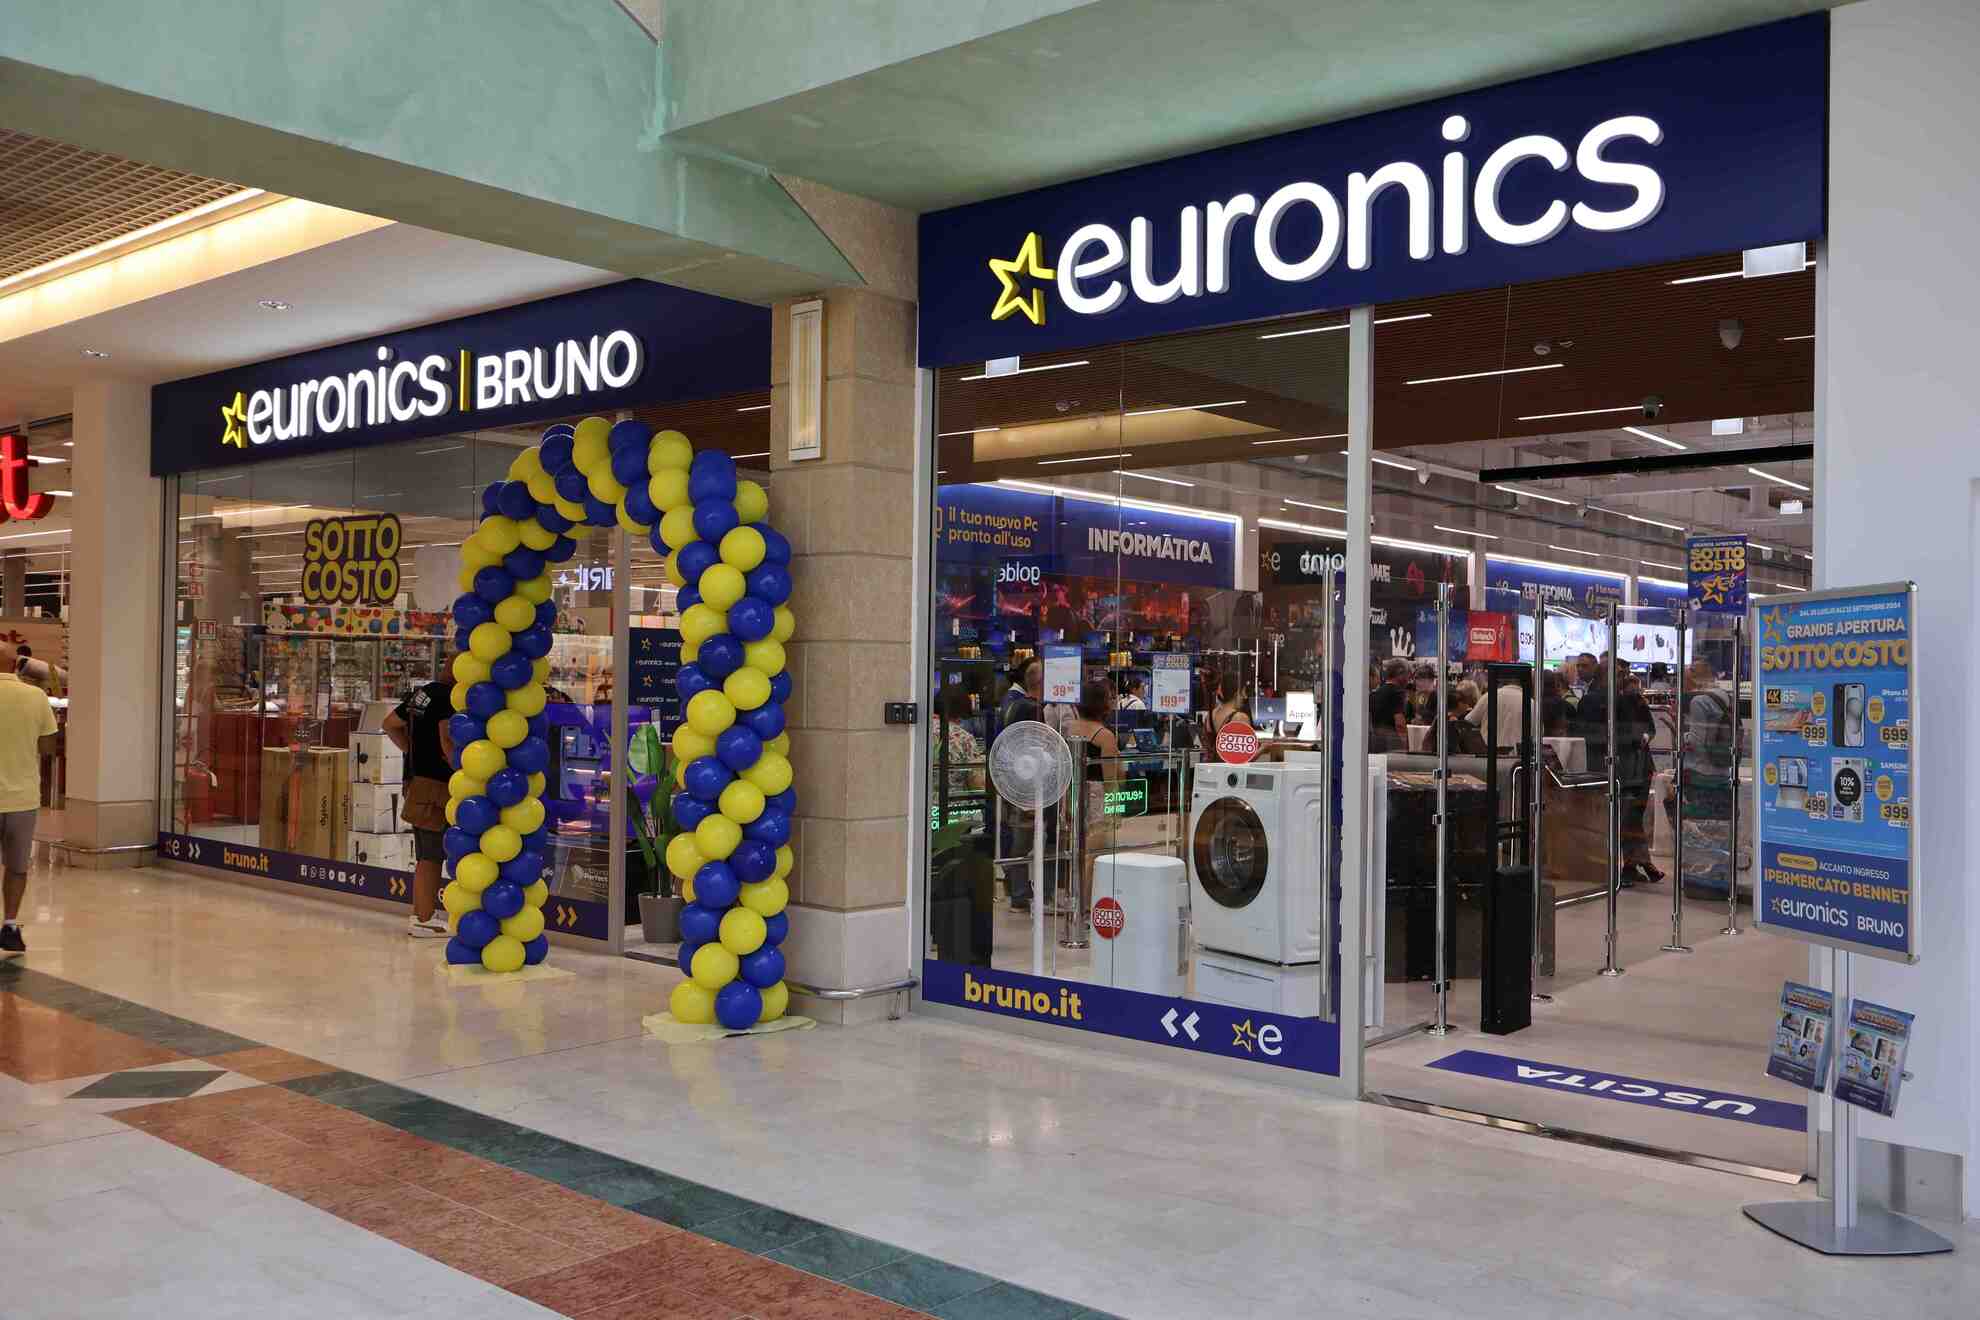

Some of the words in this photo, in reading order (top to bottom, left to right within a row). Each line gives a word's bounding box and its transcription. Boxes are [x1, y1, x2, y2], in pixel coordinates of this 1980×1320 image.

[1056, 115, 1664, 316] euronics
[247, 346, 450, 445] euronics
[476, 330, 642, 411] BRUNO
[948, 506, 956, 522] il
[960, 509, 983, 525] tuo
[985, 514, 1021, 530] nuovo
[1023, 516, 1039, 532] Pc
[305, 517, 400, 561] SOTTO
[948, 528, 992, 544] pronto
[1690, 546, 1745, 560] SOTTO
[1690, 558, 1745, 572] COSTO
[302, 559, 399, 602] COSTO
[1786, 623, 1834, 639] GRANDE
[1835, 617, 1906, 635] APERTURA
[1760, 639, 1909, 672] SOTTOCOSTO
[1219, 734, 1256, 744] SOTTO
[1804, 726, 1825, 739] 999
[1882, 728, 1908, 741] 699
[1219, 743, 1255, 753] COSTO
[1884, 805, 1909, 819] 399
[223, 847, 270, 873] bruno.it
[1819, 861, 1853, 875] ACCANTO
[1853, 866, 1890, 880] INGRESSO
[1764, 867, 1851, 896] IPERMERCATO
[1853, 882, 1909, 905] BENNET
[1780, 898, 1849, 927] euronics
[1856, 915, 1905, 938] BRUNO
[964, 972, 1083, 1021] bruno.it
[1516, 1064, 1757, 1116] USCITA
